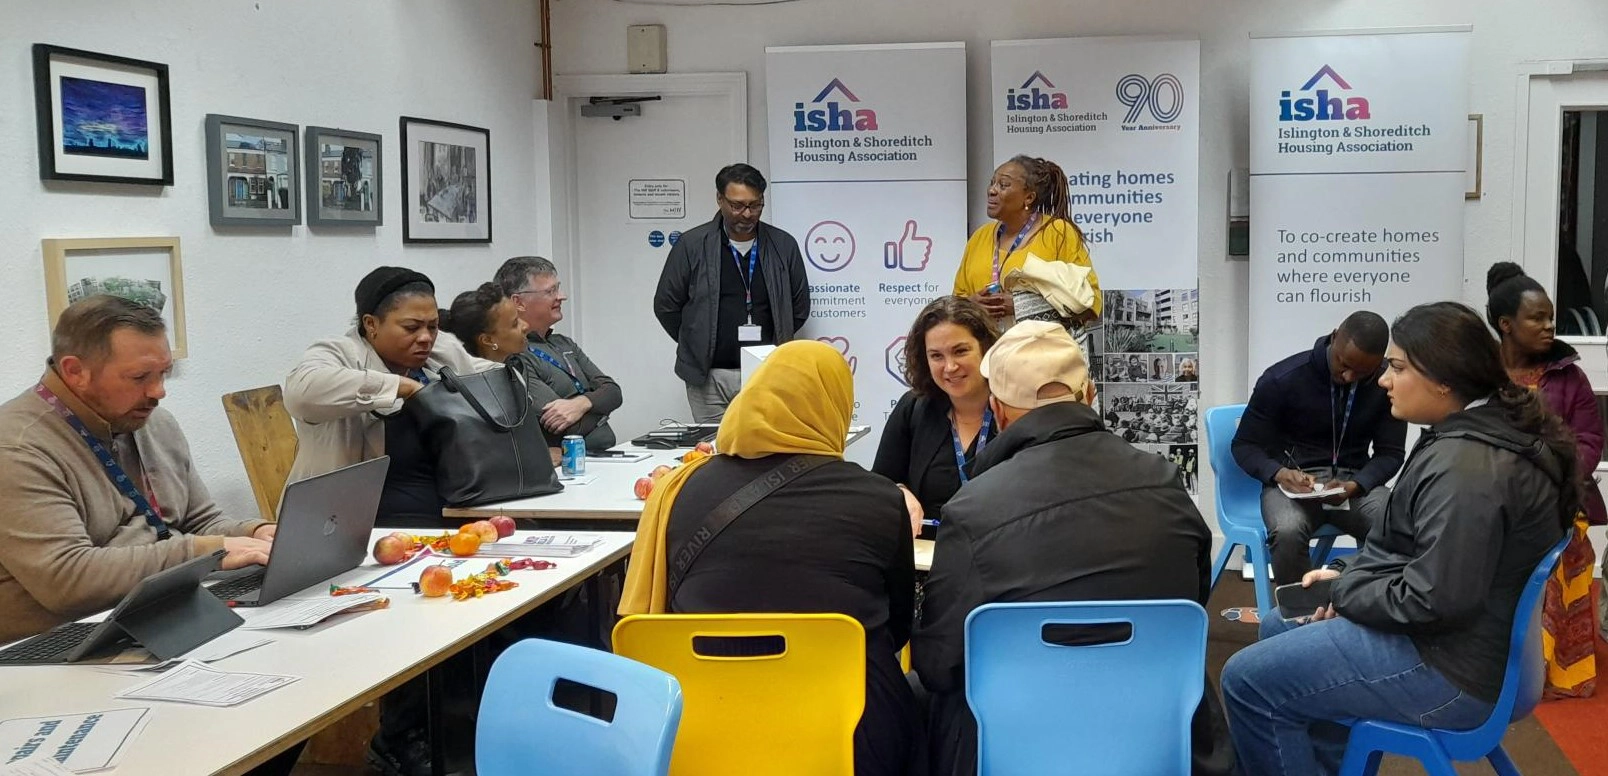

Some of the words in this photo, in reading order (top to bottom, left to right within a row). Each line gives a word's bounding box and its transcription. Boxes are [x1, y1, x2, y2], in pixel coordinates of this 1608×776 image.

[1007, 88, 1068, 111] isha
[1116, 73, 1184, 124] 90
[1279, 90, 1371, 121] isha
[794, 102, 878, 131] isha
[1006, 114, 1048, 125] Islington
[1057, 112, 1108, 121] Shoreditch
[1006, 125, 1044, 134] Housing
[1046, 123, 1097, 132] Association
[1278, 127, 1340, 140] Islington
[1343, 127, 1351, 137] &
[1354, 125, 1431, 137] Shoreditch
[794, 137, 850, 150] Islington
[853, 138, 861, 147] &
[863, 135, 932, 147] Shoreditch
[1278, 142, 1333, 155] Housing
[1335, 140, 1413, 152] Association
[794, 151, 845, 164] Housing
[847, 149, 918, 161] Association
[1117, 170, 1175, 184] homes
[1073, 211, 1153, 227] everyone
[1278, 229, 1296, 244] To
[1300, 231, 1378, 243] co-create
[1383, 228, 1440, 243] homes
[1277, 249, 1307, 263] and
[1312, 248, 1421, 263] communities
[1277, 269, 1328, 283] where
[1333, 272, 1411, 286] everyone
[808, 283, 861, 293] assionate
[879, 283, 922, 294] Respect
[924, 282, 940, 293] for
[1276, 291, 1305, 303] can
[1310, 288, 1372, 303] flourish
[810, 309, 867, 318] customers
[676, 526, 712, 571] RIVER
[34, 719, 62, 736] and
